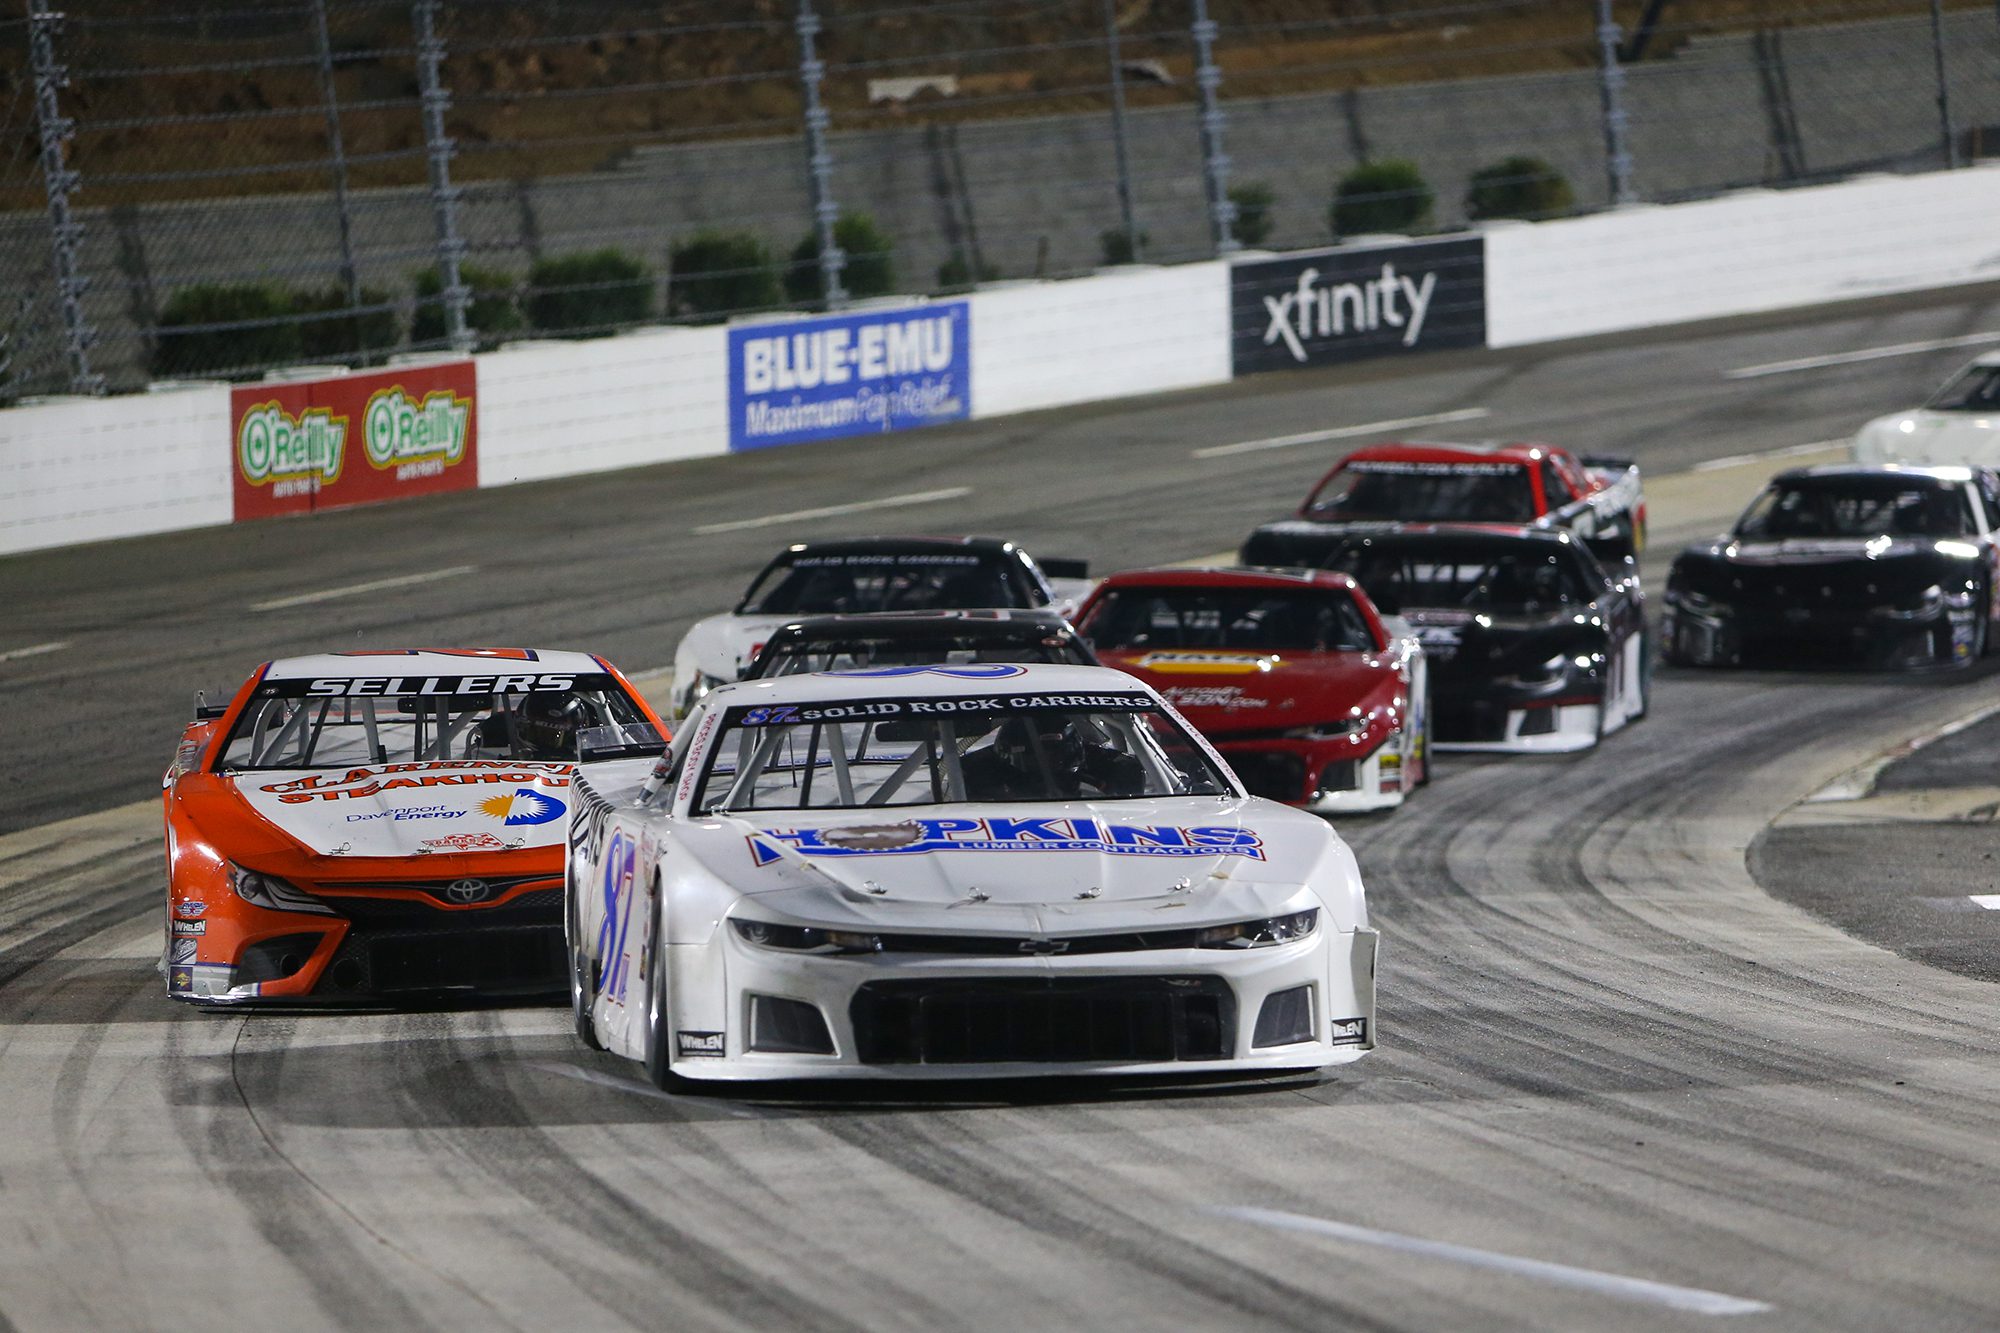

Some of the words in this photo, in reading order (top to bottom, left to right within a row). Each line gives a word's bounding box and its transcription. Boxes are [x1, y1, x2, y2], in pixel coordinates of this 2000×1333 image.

[1262, 261, 1437, 362] xfinity
[744, 315, 953, 396] BLUE-EMU
[366, 390, 467, 463] O'Reilly
[745, 396, 856, 438] Maximum
[241, 408, 345, 479] O'Reilly
[306, 674, 577, 697] SELLERS
[741, 706, 799, 725] 87
[801, 703, 900, 720] SOLID
[909, 698, 1004, 713] ROCK
[1009, 696, 1152, 708] CARRIERS
[278, 773, 570, 804] STEAKHOU
[346, 804, 447, 822] Davenport
[394, 808, 469, 822] Energy
[959, 841, 1059, 850] LUMBER
[1068, 841, 1251, 855] CONTRACTORS
[174, 920, 206, 932] WHELEN
[678, 1033, 724, 1049] WHELEN
